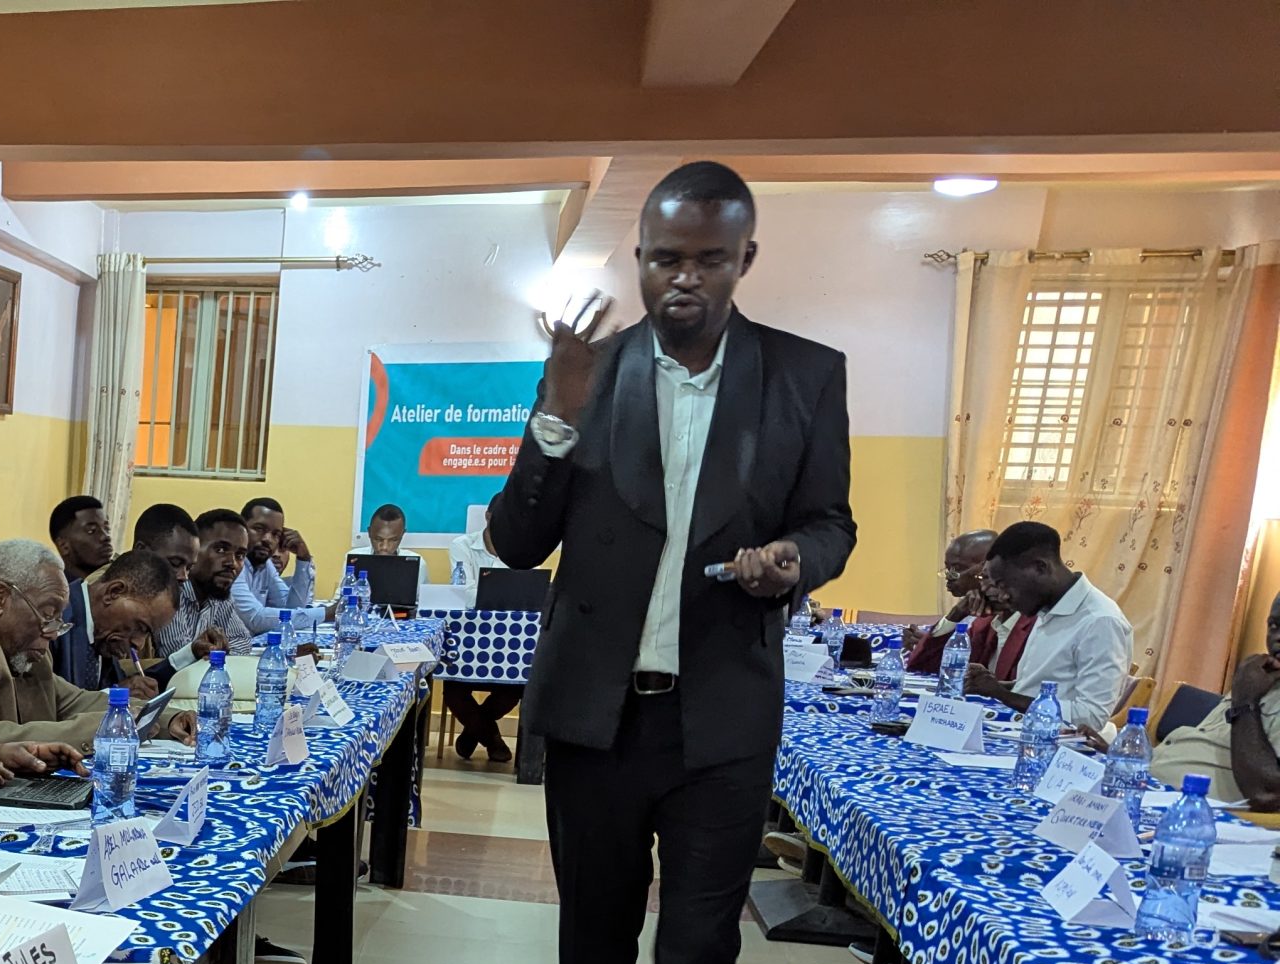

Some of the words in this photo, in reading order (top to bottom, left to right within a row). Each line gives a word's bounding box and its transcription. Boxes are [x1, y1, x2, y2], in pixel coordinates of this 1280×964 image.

[391, 403, 441, 423] Atelier
[444, 403, 462, 422] de
[467, 403, 530, 423] formatio
[450, 444, 471, 455] Dans
[473, 444, 481, 455] le
[483, 444, 506, 455] cadre
[487, 458, 507, 469] pour
[923, 701, 956, 715] ISRAEL
